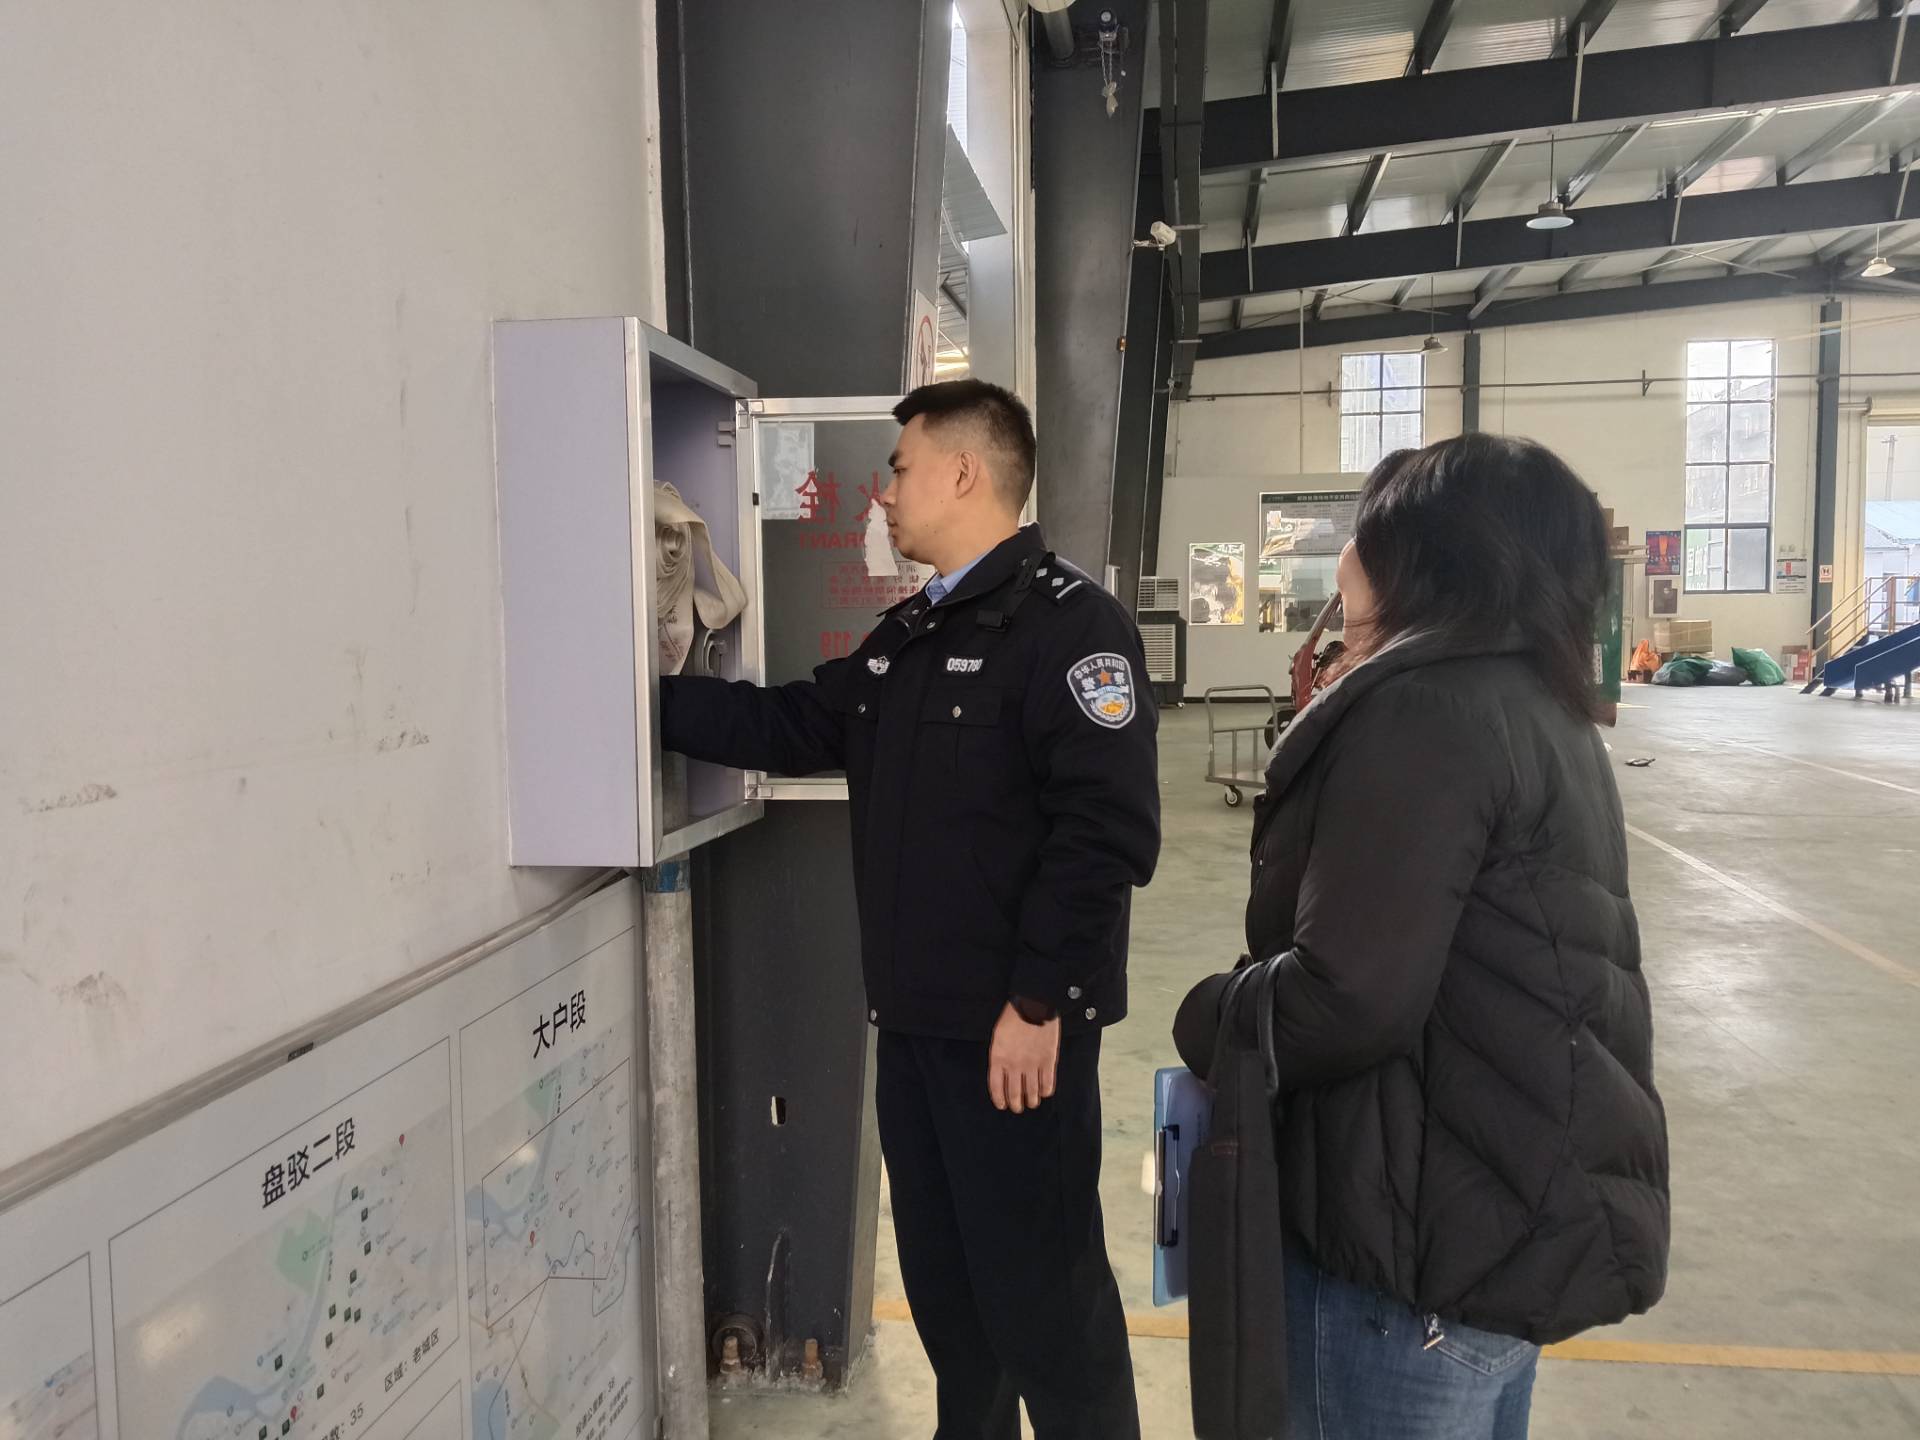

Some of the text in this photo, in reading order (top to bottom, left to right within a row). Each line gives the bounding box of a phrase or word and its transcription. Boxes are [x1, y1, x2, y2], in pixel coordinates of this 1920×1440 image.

[532, 989, 586, 1060] 大户段
[261, 1116, 356, 1209] 盘驳二段
